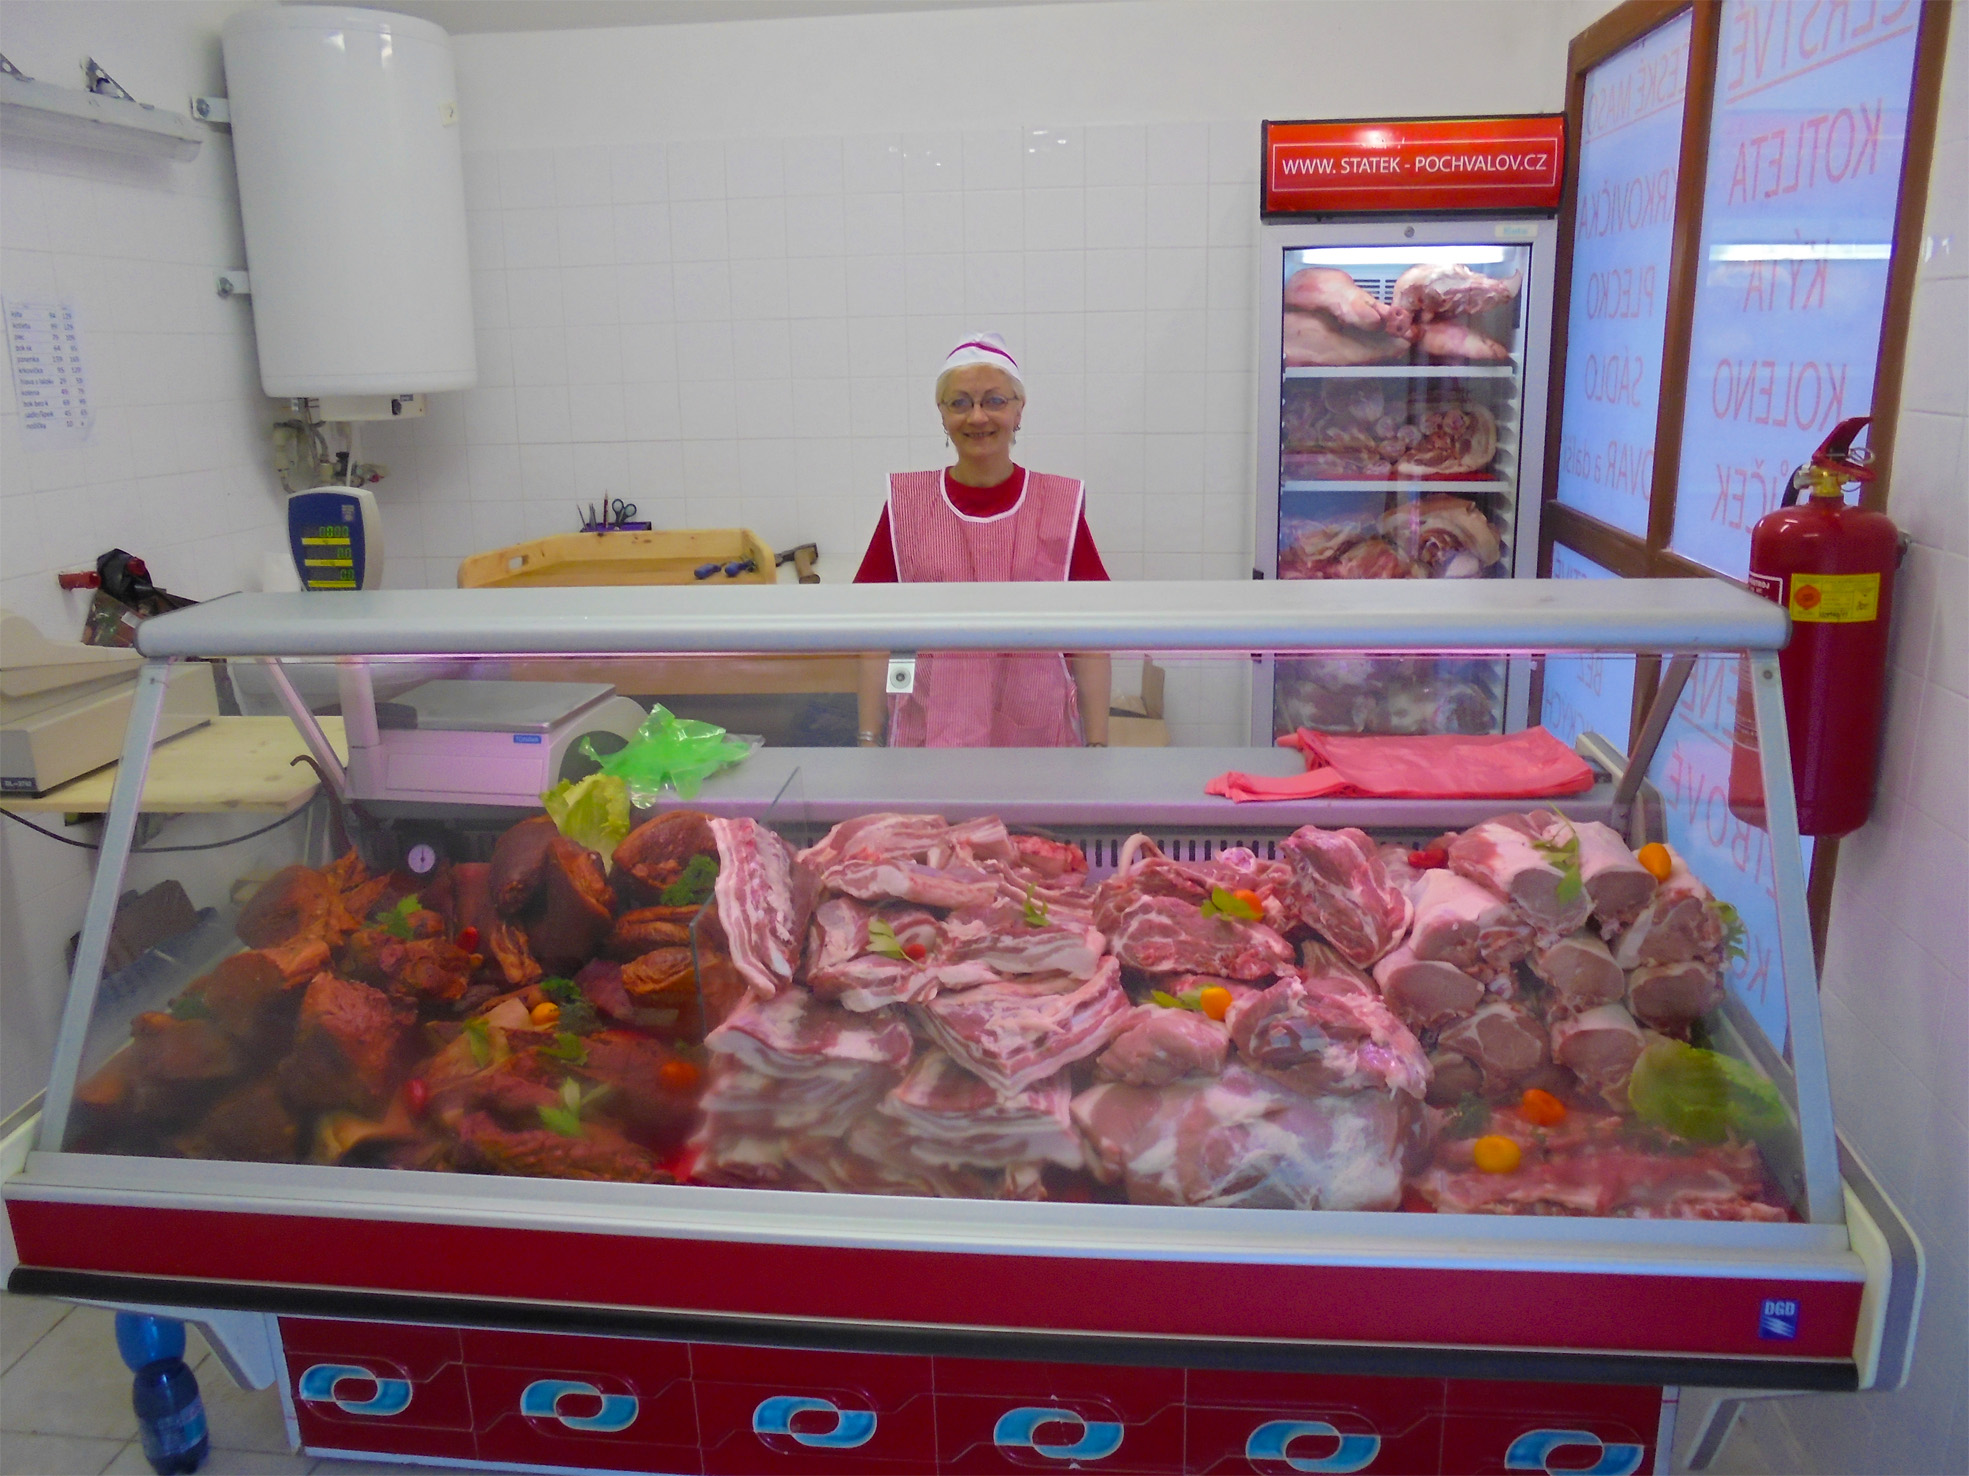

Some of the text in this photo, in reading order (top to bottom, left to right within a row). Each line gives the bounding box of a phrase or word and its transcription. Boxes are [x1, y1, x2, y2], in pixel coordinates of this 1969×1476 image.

[1282, 158, 1336, 175] WWW.
[1341, 156, 1400, 174] STATEK
[1415, 153, 1547, 173] POCHVALOV.CZ
[1764, 1301, 1796, 1316] DGD
